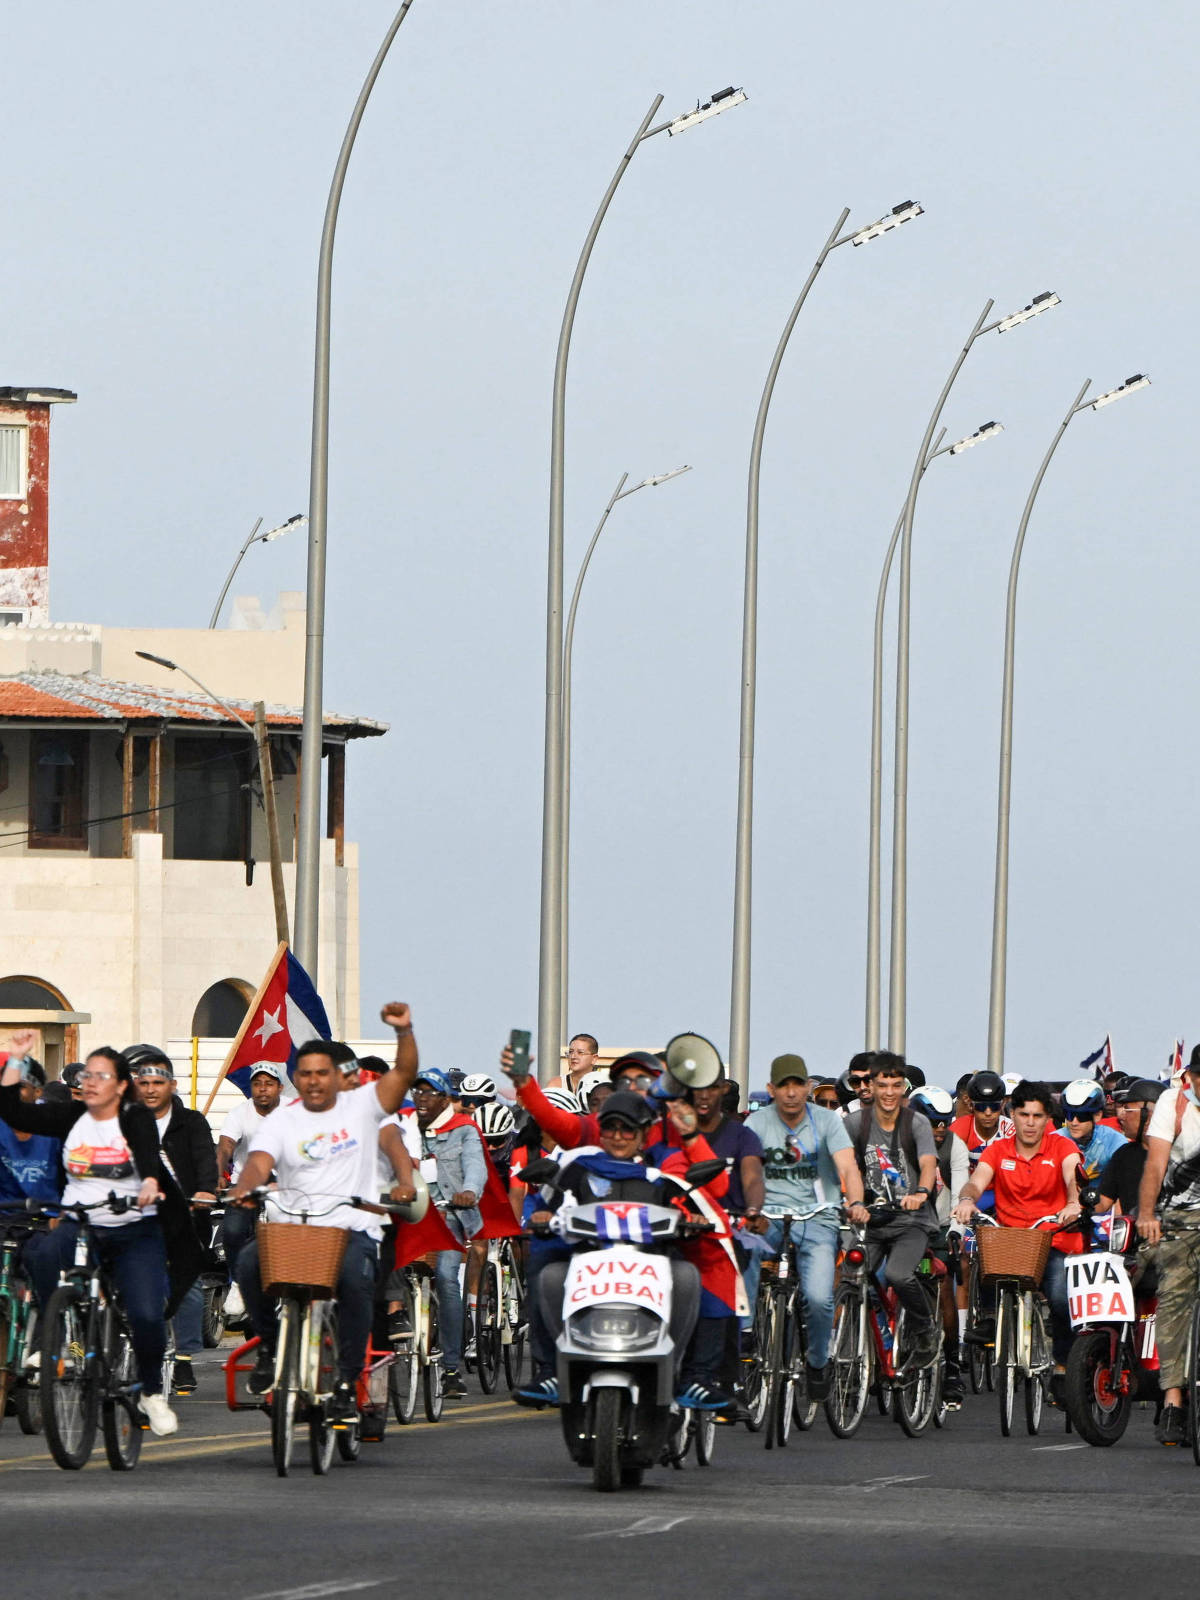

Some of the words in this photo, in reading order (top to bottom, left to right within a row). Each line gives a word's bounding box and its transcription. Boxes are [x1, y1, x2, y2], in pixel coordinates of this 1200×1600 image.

[331, 1127, 349, 1143] 65
[1066, 1261, 1121, 1288] IVA
[571, 1282, 664, 1307] CUBA!
[1069, 1291, 1128, 1320] UBA
